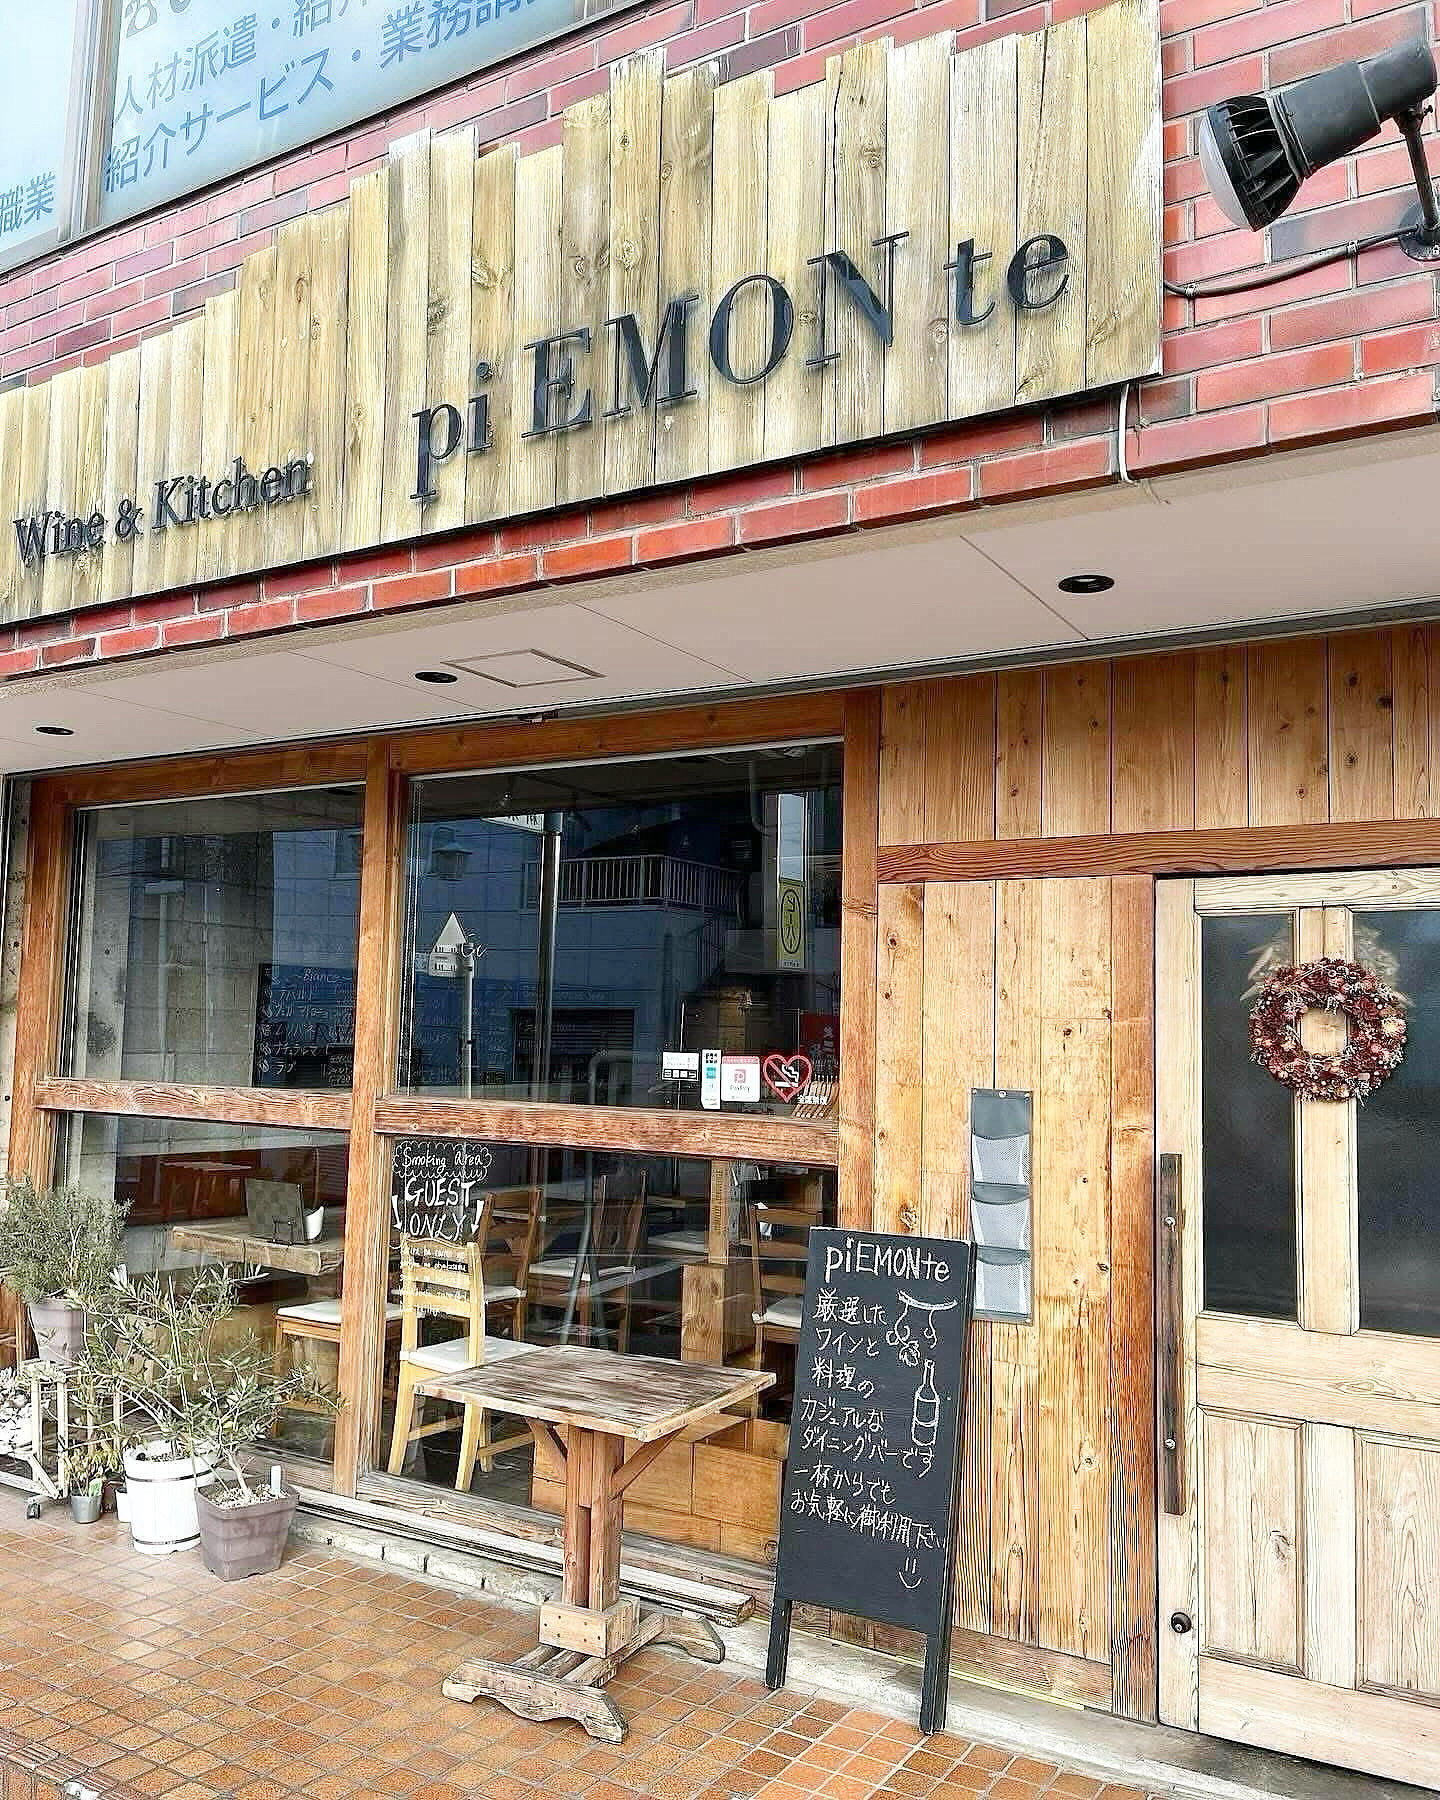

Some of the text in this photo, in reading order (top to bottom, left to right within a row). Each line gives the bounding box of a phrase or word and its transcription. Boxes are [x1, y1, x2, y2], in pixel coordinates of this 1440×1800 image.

[411, 230, 1071, 500] piEMONte
[13, 456, 312, 567] Wine & Kitchen
[403, 1146, 446, 1173] Smoking
[405, 1177, 477, 1208] GUEST
[409, 1212, 467, 1242] ONLY
[812, 1287, 888, 1326] 厳選した
[815, 1327, 880, 1358] ワインと
[811, 1356, 875, 1399] 料理の
[801, 1395, 885, 1433] カジュアルな
[801, 1425, 935, 1479] ダイニングバーです
[793, 1459, 896, 1505] 一杯からでも
